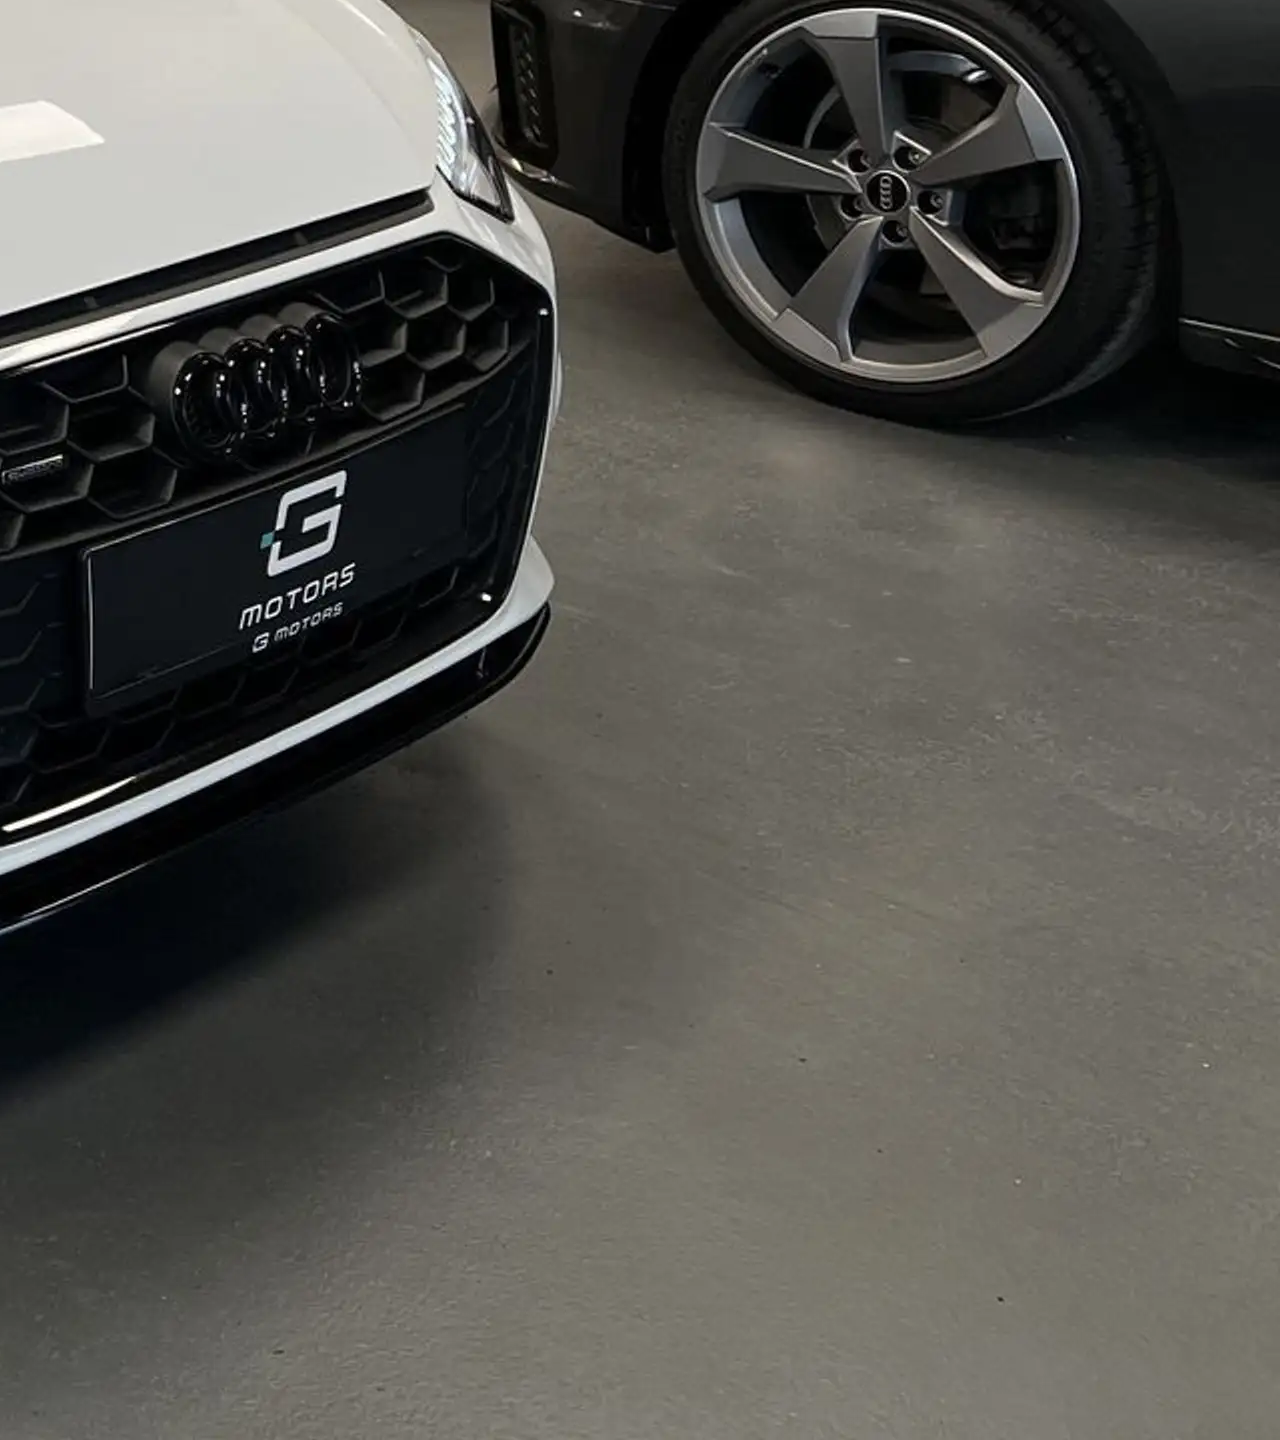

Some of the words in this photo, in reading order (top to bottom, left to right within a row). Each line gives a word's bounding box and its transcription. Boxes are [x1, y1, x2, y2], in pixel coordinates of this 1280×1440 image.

[239, 562, 356, 630] MOTORS
[252, 632, 270, 653] G
[274, 602, 343, 641] MOTORS
